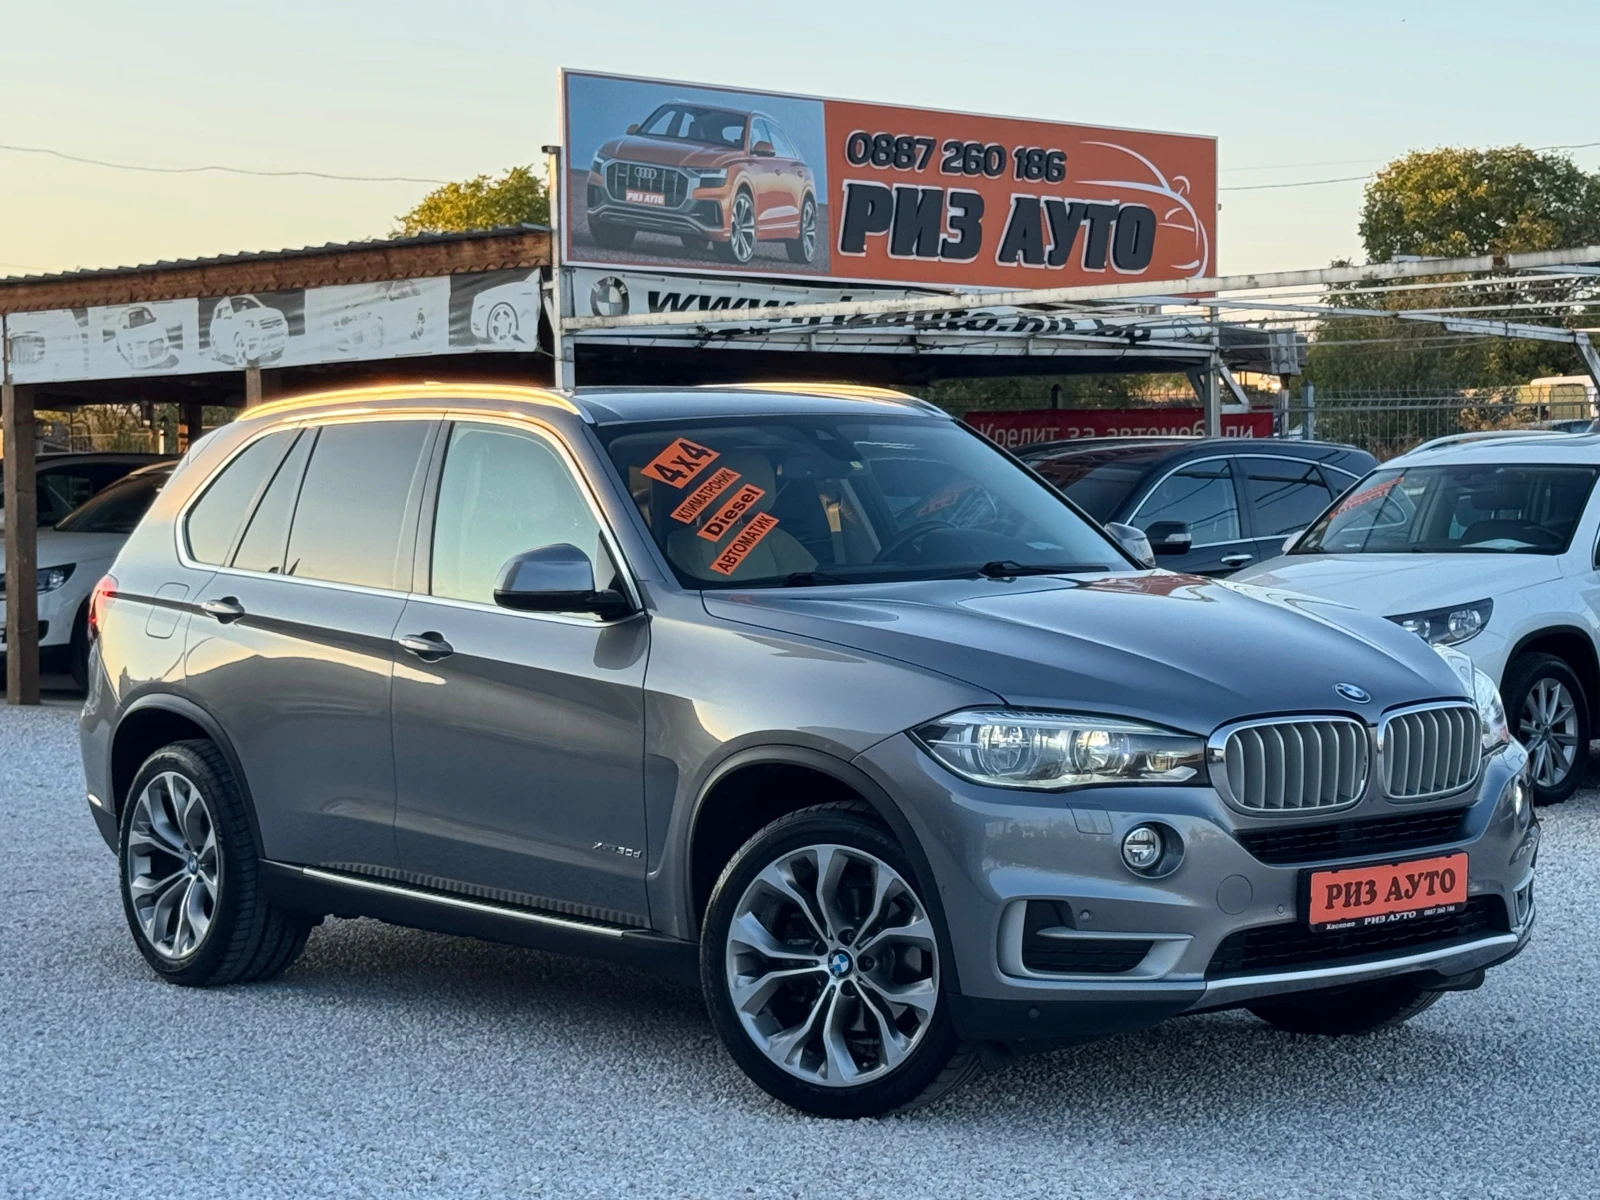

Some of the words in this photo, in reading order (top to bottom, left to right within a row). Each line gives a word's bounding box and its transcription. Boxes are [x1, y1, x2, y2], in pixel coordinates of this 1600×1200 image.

[845, 130, 937, 172] 0887
[940, 139, 1007, 179] 260
[1012, 145, 1068, 183] 186
[838, 179, 985, 263] РИЗ
[995, 193, 1157, 275] АУТО
[1107, 420, 1254, 439] автомобли
[653, 442, 713, 483] 4x4
[676, 469, 737, 521] КЛИМАТРОНИК
[704, 487, 761, 537] Diesel
[717, 515, 774, 573] АВТОМАТИК
[1325, 879, 1377, 910] РИЗ
[1384, 868, 1456, 903] АУТО
[1364, 916, 1386, 926] РИЗ
[1387, 910, 1416, 922] АУТО
